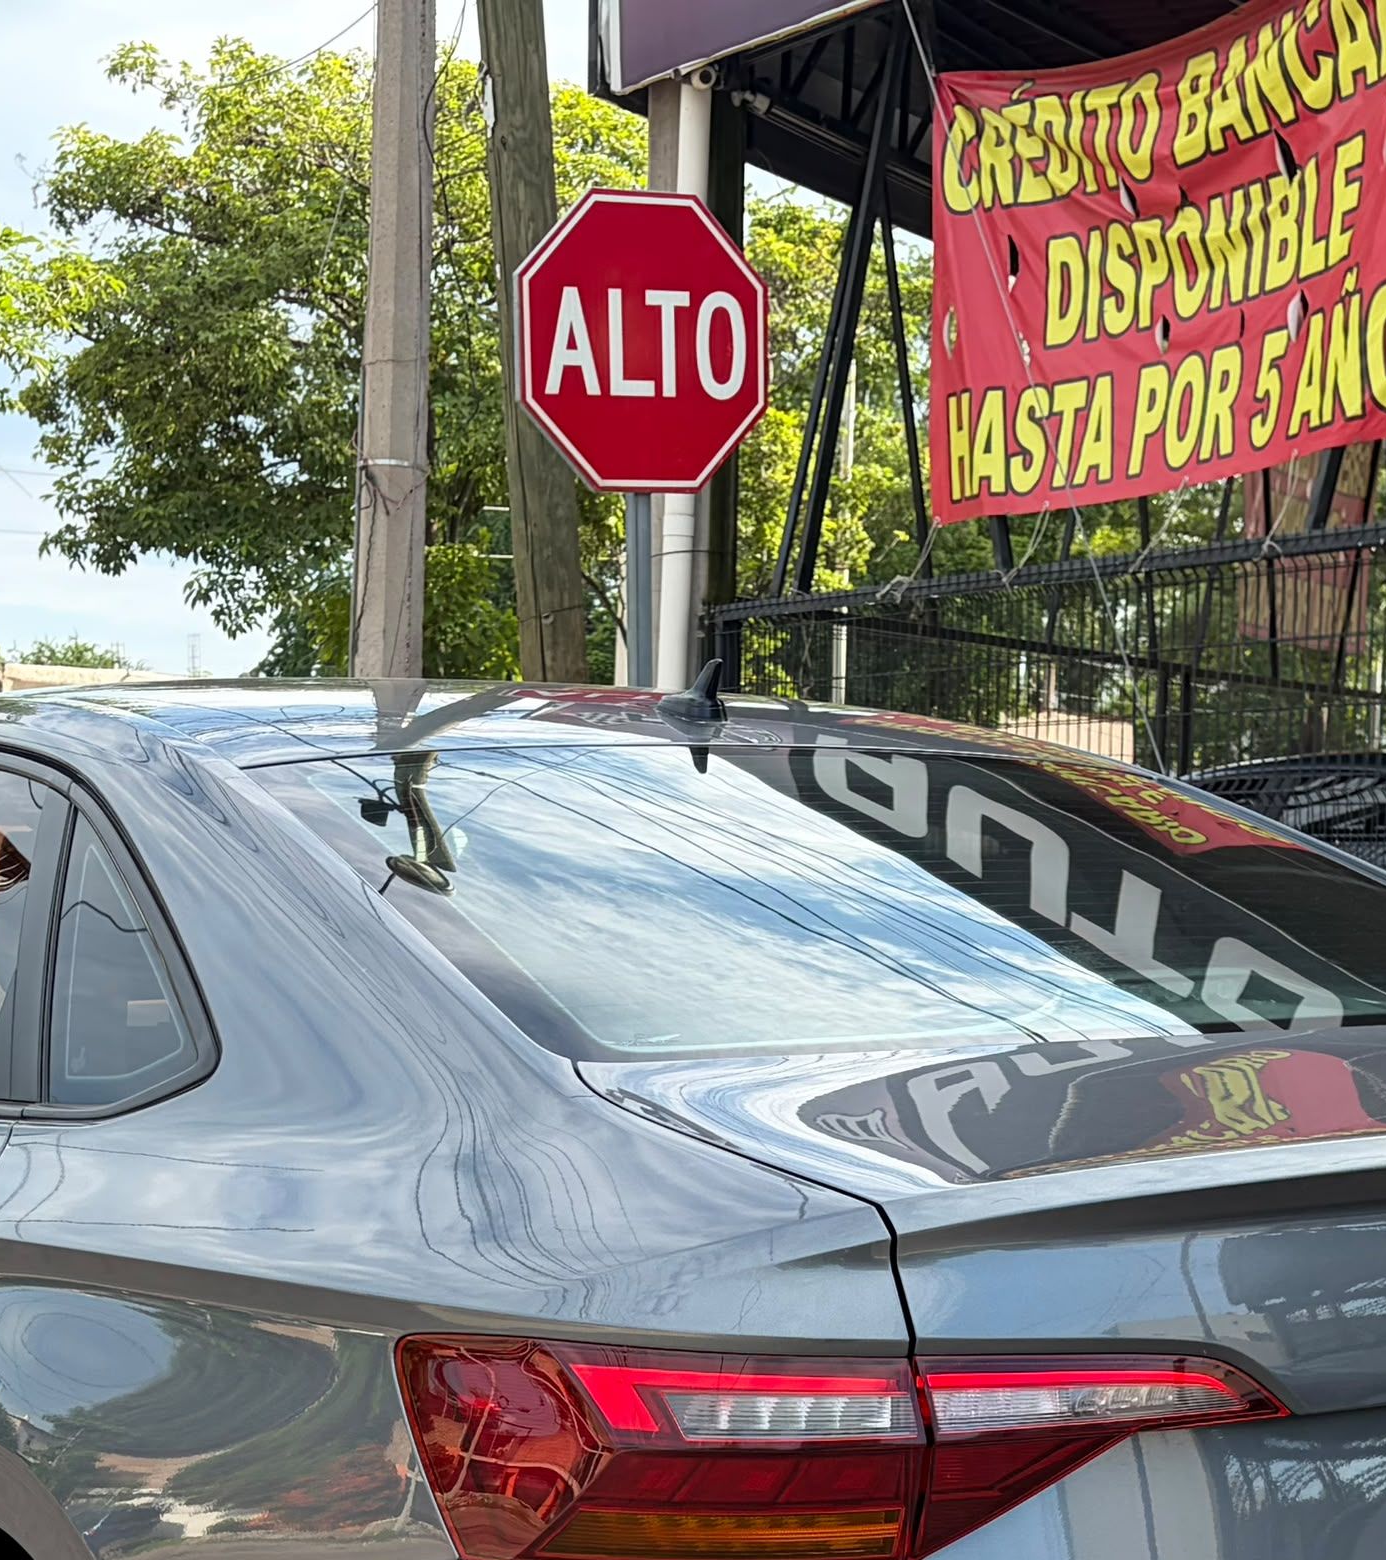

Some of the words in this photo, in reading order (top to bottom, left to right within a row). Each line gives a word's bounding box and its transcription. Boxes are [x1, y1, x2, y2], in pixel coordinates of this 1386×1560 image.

[942, 71, 1161, 214] CRÉDITO
[1043, 131, 1364, 348] DISPONIBLE
[545, 286, 747, 401] ALTO
[946, 373, 1114, 502] HASTA
[1126, 344, 1242, 477] POR
[1249, 326, 1290, 450] 5
